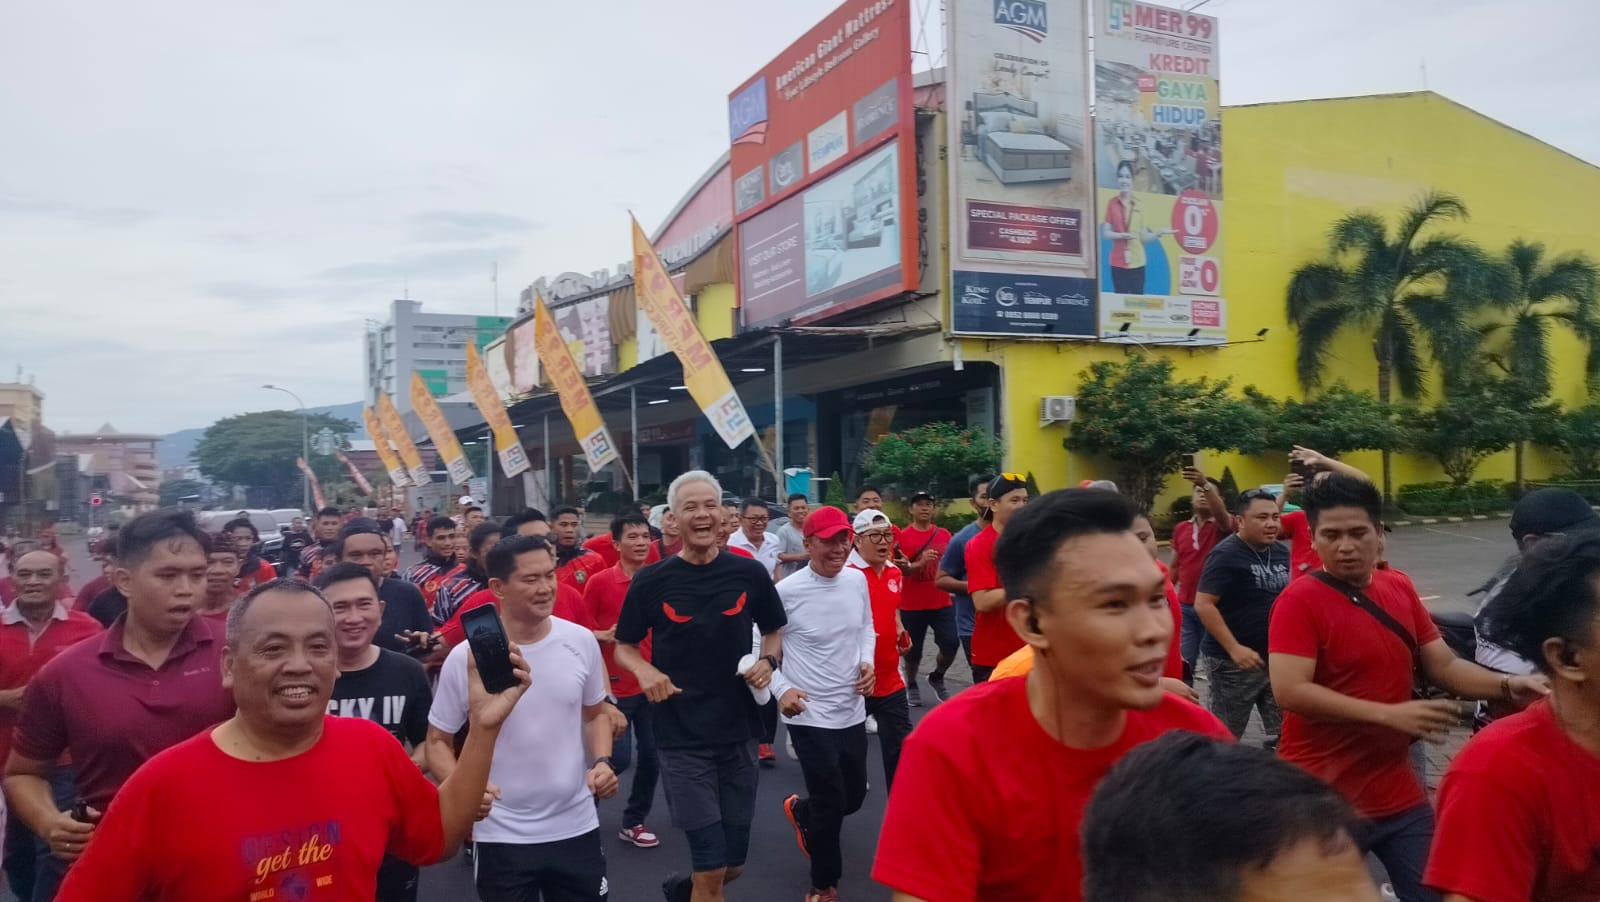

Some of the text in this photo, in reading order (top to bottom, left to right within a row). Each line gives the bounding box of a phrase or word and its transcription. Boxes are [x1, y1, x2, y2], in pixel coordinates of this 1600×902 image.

[994, 0, 1046, 27] AGM
[1135, 4, 1212, 39] MER 99
[817, 29, 844, 59] Giant
[1149, 53, 1210, 75] KREDIT
[1157, 80, 1206, 100] GAYA
[732, 88, 766, 132] AGM
[1152, 105, 1206, 124] HIDUP
[970, 208, 1078, 226] SPECIAL PACKAGE OFFER
[327, 695, 406, 725] CKY IV
[255, 834, 333, 885] get the
